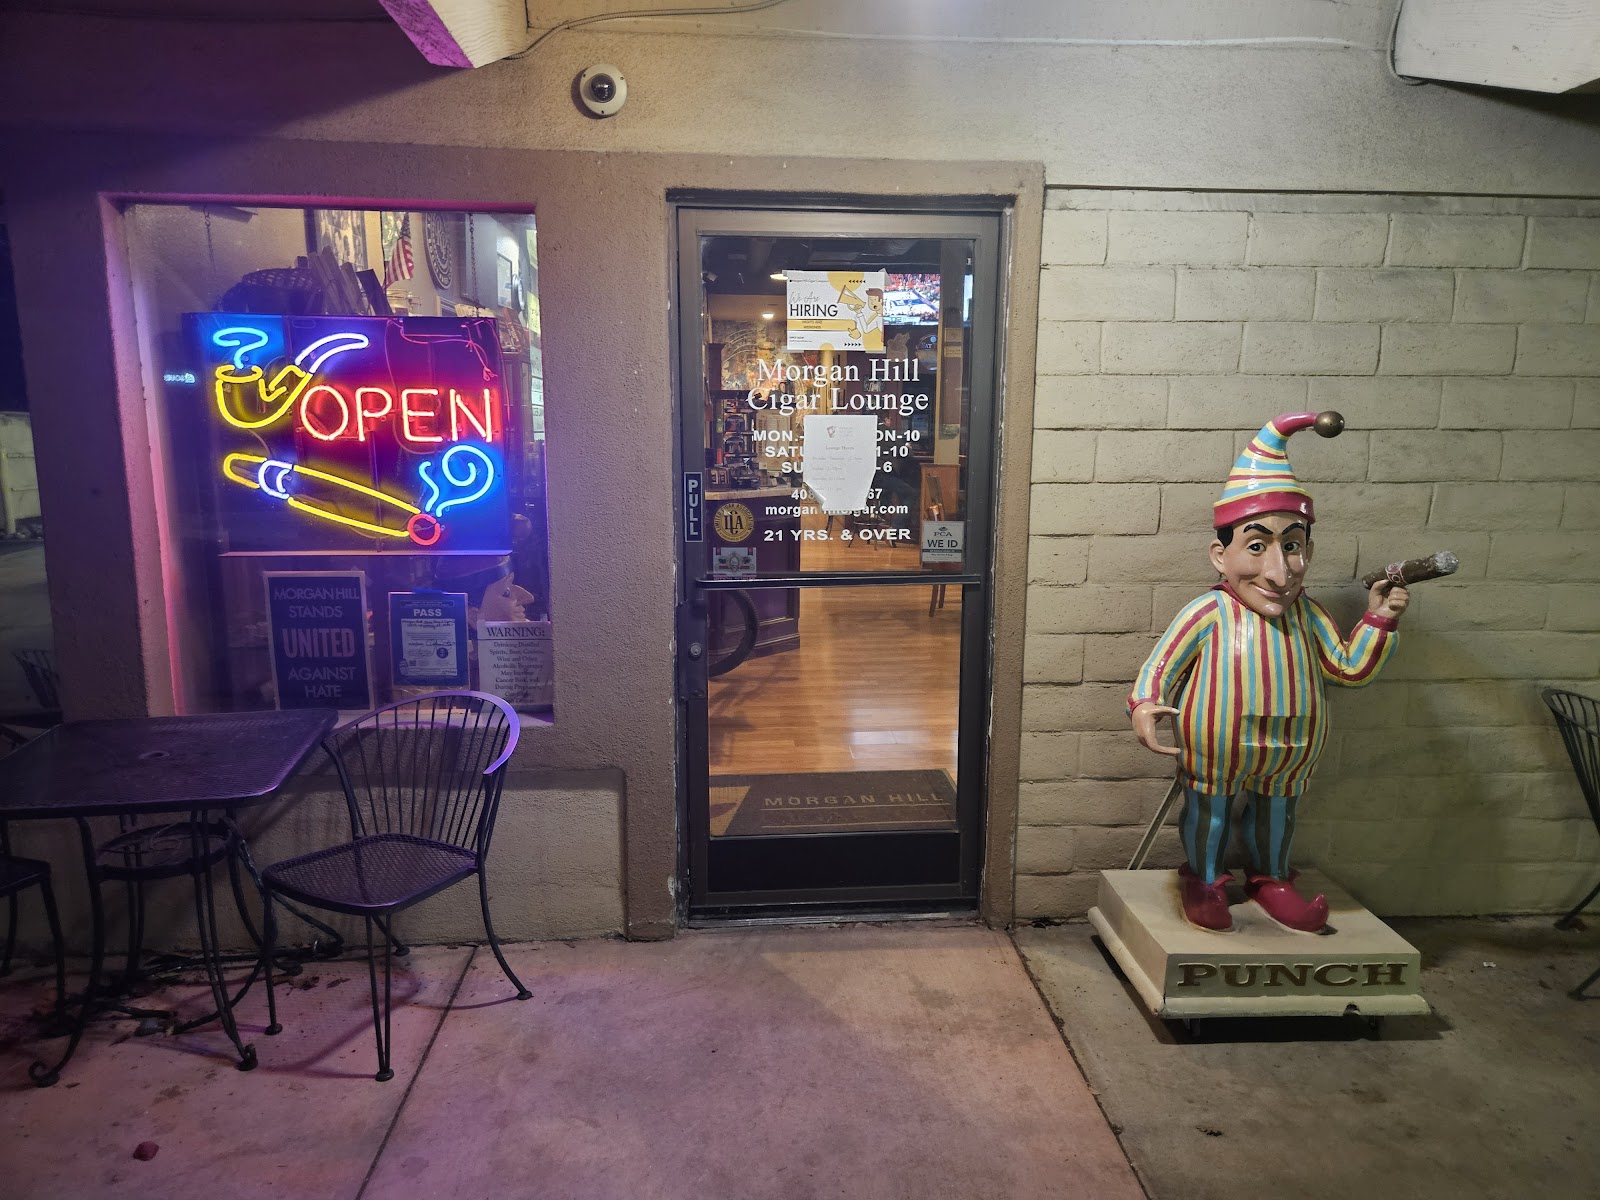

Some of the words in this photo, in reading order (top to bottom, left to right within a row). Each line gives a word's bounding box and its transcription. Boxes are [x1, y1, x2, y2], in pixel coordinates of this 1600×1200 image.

[789, 304, 838, 317] HIRING
[757, 358, 860, 387] Morgan
[869, 358, 920, 382] Hill
[746, 388, 821, 416] Cigar
[830, 388, 929, 416] Lounge
[300, 385, 492, 442] OPEN
[781, 461, 804, 473] SU
[688, 479, 699, 536] PULL
[764, 530, 784, 542] 21
[791, 529, 834, 541] YRS.
[840, 529, 853, 541] &
[860, 528, 911, 541] OVER
[927, 539, 944, 548] WE
[947, 539, 958, 548] ID
[274, 587, 333, 600] MORGAN
[335, 587, 360, 600] HILL
[288, 605, 343, 618] STANDS
[413, 608, 442, 617] PASS
[486, 626, 545, 637] WARNING:
[281, 627, 355, 659] UNITED
[287, 666, 357, 681] AGAINST
[304, 684, 343, 698] HATE
[765, 794, 876, 806] MORGAN
[889, 792, 943, 804] HILL
[1177, 961, 1409, 988] PUNCH
